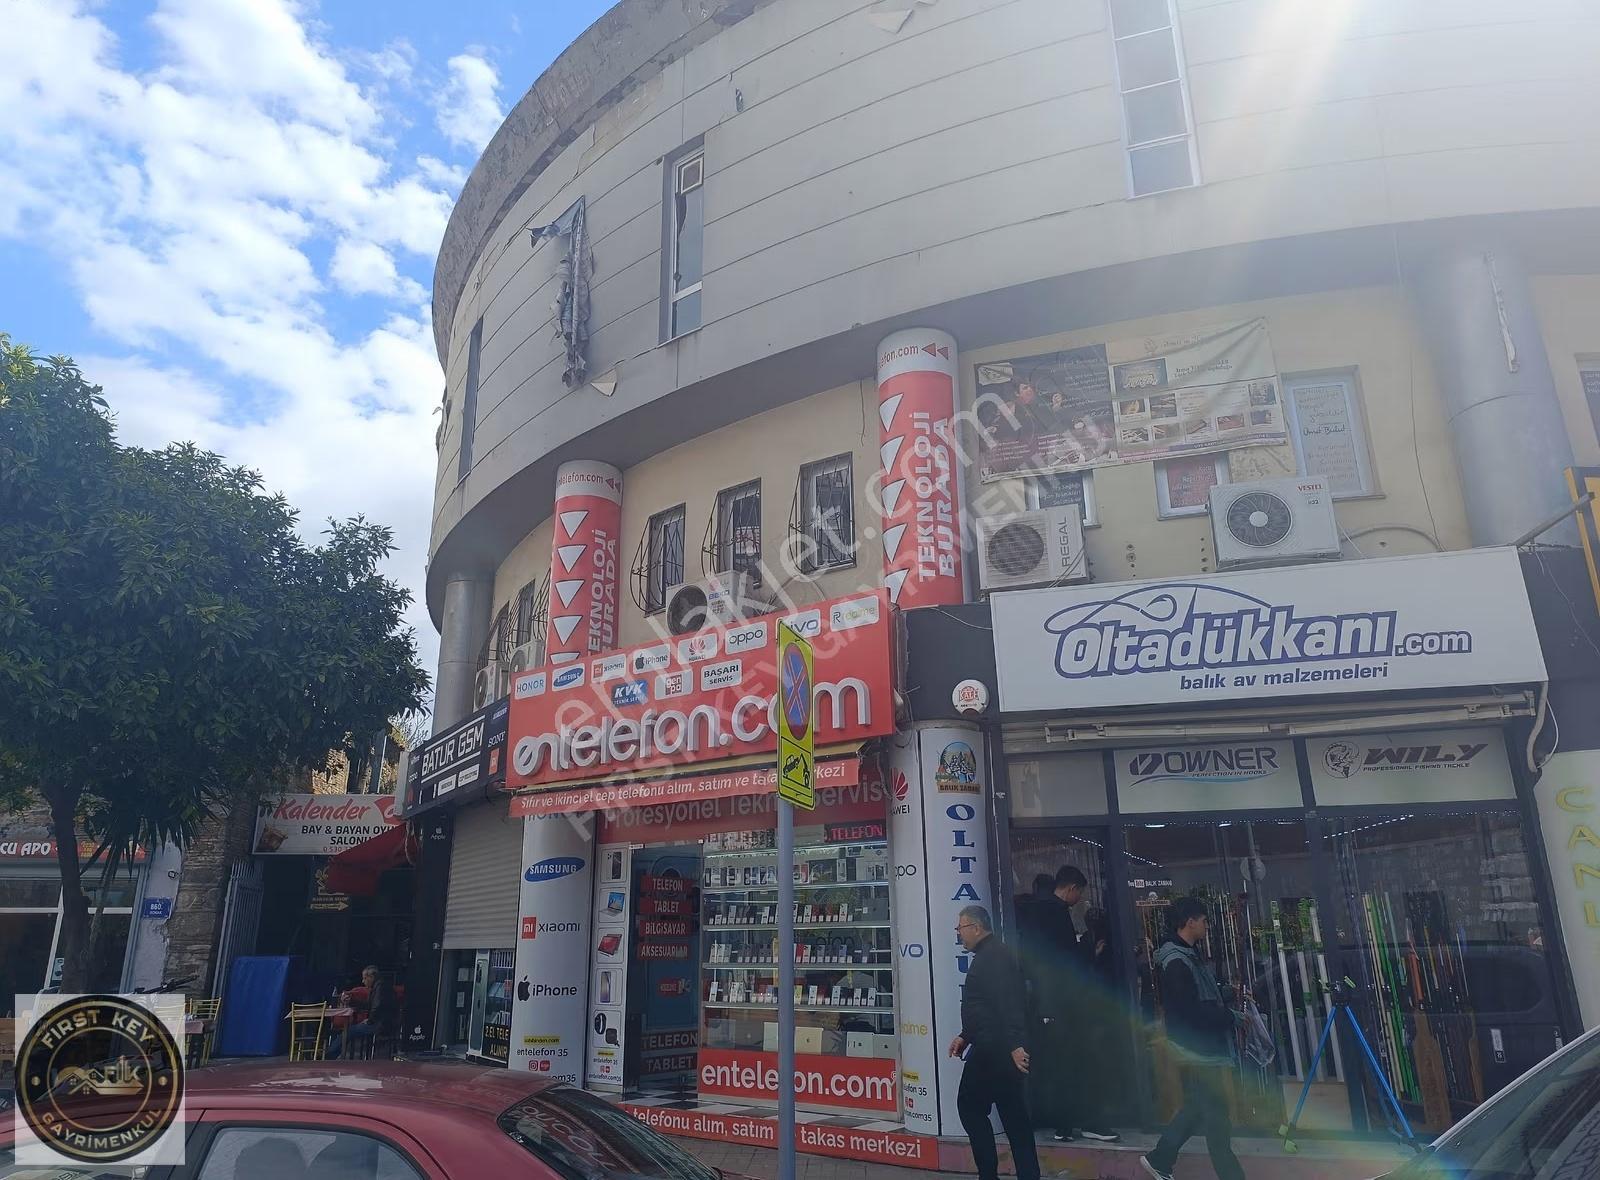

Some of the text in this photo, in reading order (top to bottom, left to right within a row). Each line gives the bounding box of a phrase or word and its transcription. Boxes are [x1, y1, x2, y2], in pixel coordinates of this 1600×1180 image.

[933, 416, 956, 578] BURADA
[1058, 516, 1070, 569] REGAL
[587, 528, 607, 657] EKNOLOJİ
[788, 618, 818, 633] ivo
[728, 629, 764, 646] oppo
[644, 654, 669, 666] iPhone
[556, 671, 581, 683] SAMSUNG
[703, 664, 740, 679] BAŞARI
[1180, 661, 1389, 691] balık av malzemeleri
[516, 678, 545, 694] HONOR
[708, 675, 734, 685] SERVİS
[614, 682, 644, 698] KVK
[421, 738, 456, 777] BATUR
[457, 722, 485, 758] GSM
[1363, 743, 1489, 765] WILY
[1163, 747, 1280, 774] OWNER
[1362, 764, 1413, 772] PROFESSIONAL
[595, 789, 616, 803] cep
[618, 783, 665, 801] telefonu
[698, 776, 732, 793] satım
[735, 776, 750, 787] ve
[273, 798, 371, 821] Kalender
[301, 825, 322, 834] BAY
[324, 825, 333, 834] &
[335, 825, 370, 835] BAYAN
[20, 842, 52, 857] APO
[529, 864, 577, 875] SAMSUNG
[652, 878, 683, 891] TELEFON
[654, 900, 680, 914] TABLET
[538, 921, 580, 933] xiaomi
[645, 918, 686, 935] BİLGİSAYAR
[532, 983, 578, 997] iPhone
[642, 1031, 698, 1049] TELEFON
[516, 1047, 569, 1057] entelefon 35
[647, 1055, 694, 1073] TABLET
[700, 1059, 894, 1101] enteleon.com
[918, 1087, 927, 1096] 35
[633, 1106, 690, 1129] telefonu
[731, 1119, 775, 1140] satım
[801, 1126, 846, 1148] takas
[850, 1134, 921, 1158] merkezi
